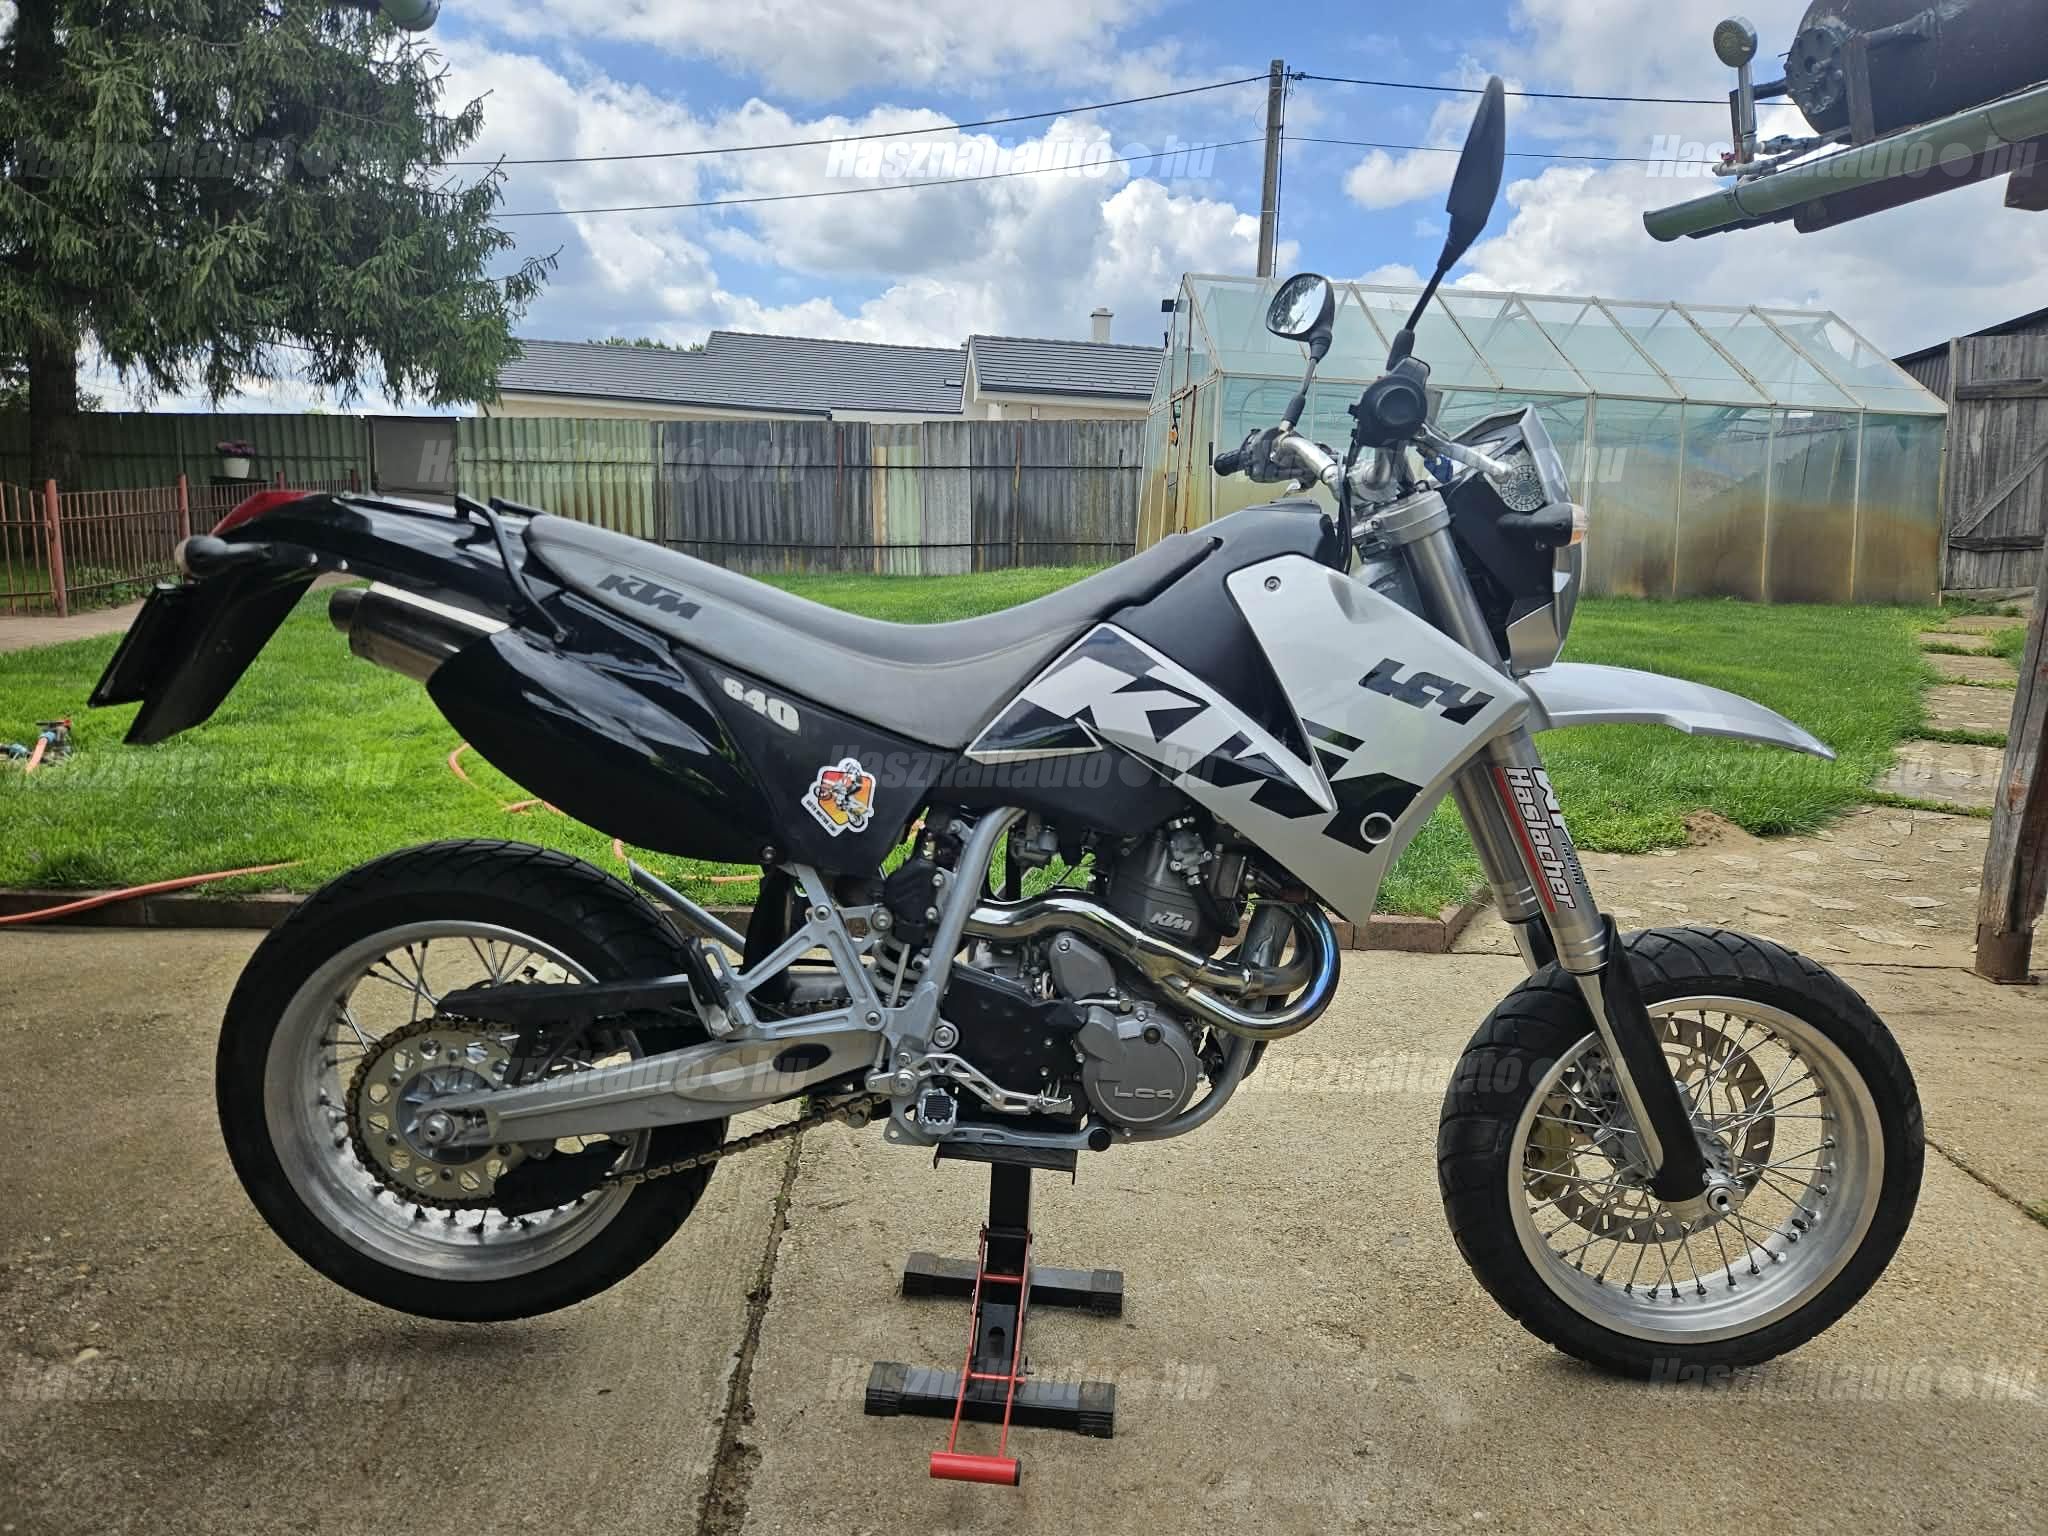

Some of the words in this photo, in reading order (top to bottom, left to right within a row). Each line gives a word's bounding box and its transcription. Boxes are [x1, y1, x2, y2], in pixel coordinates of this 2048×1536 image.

[596, 573, 702, 621] KTM
[722, 676, 801, 733] 640
[1503, 766, 1577, 910] Haslacher
[1149, 911, 1193, 931] KTM
[1113, 1085, 1176, 1100] LC4
